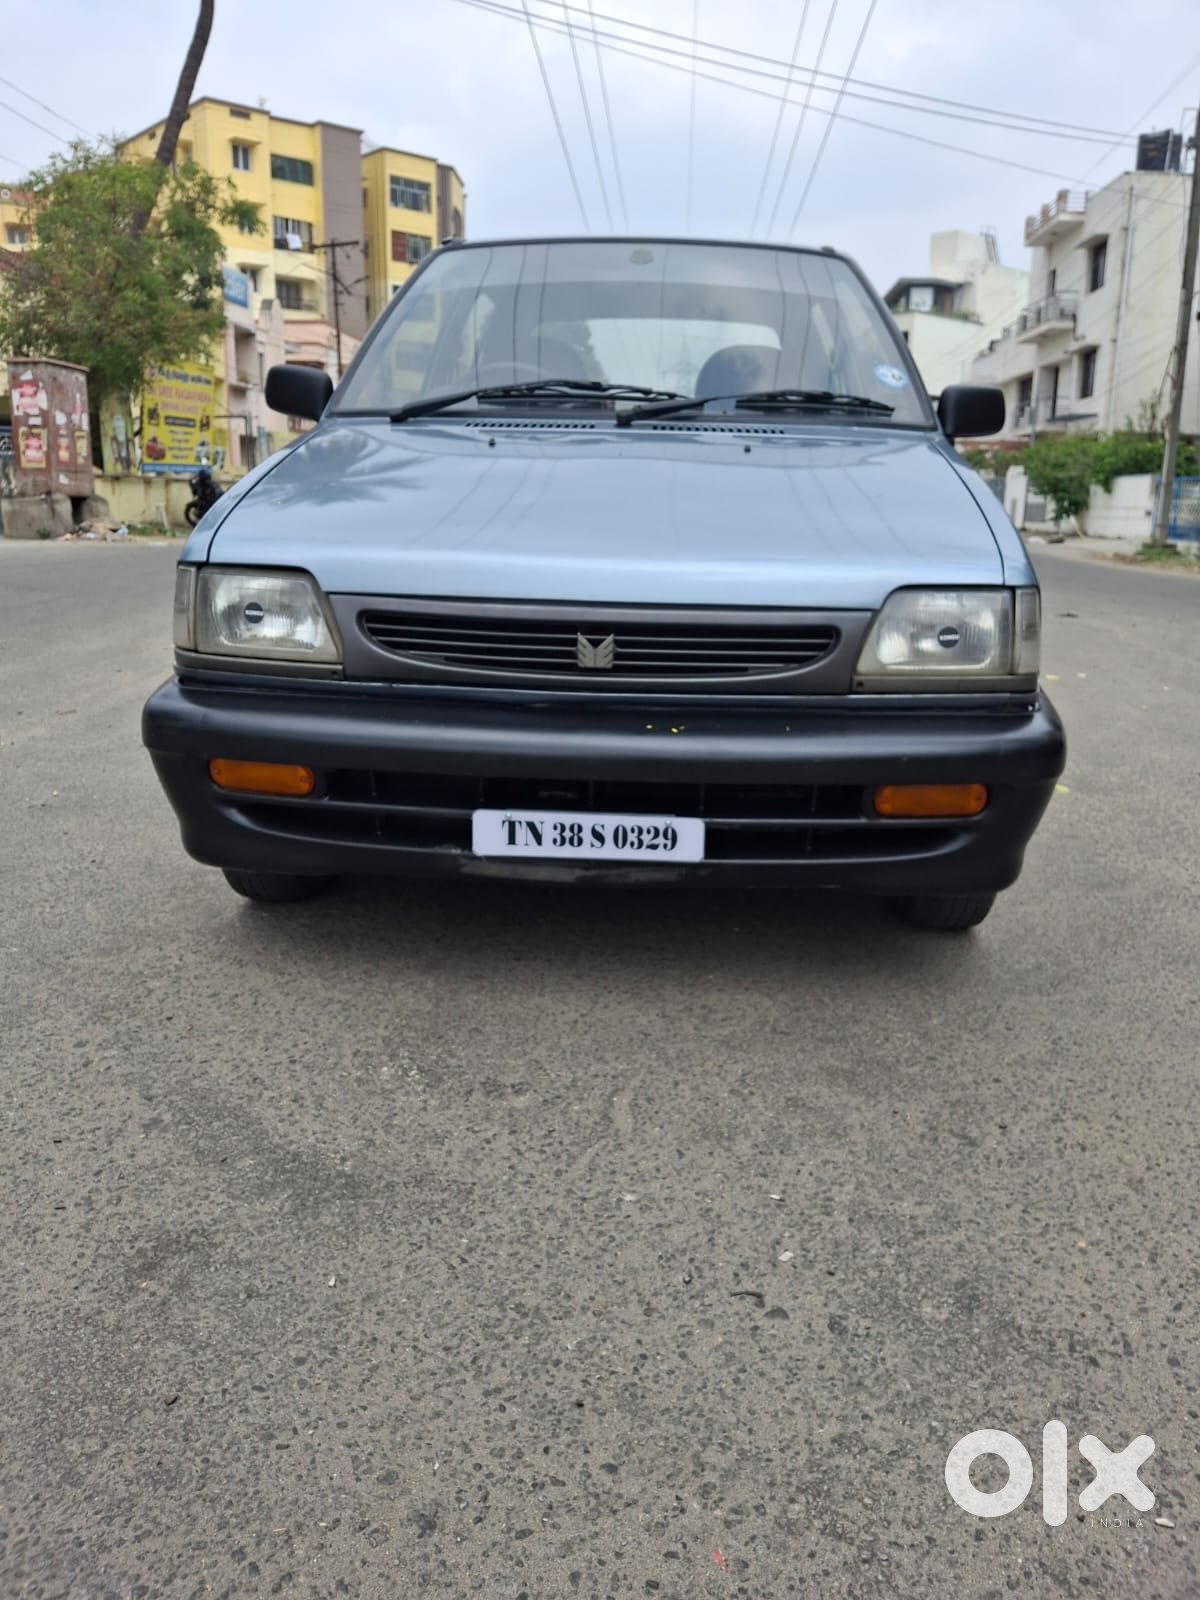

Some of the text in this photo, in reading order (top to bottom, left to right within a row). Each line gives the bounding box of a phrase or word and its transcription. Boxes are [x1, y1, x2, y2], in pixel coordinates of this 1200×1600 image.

[502, 819, 678, 851] TN 38 S 0329
